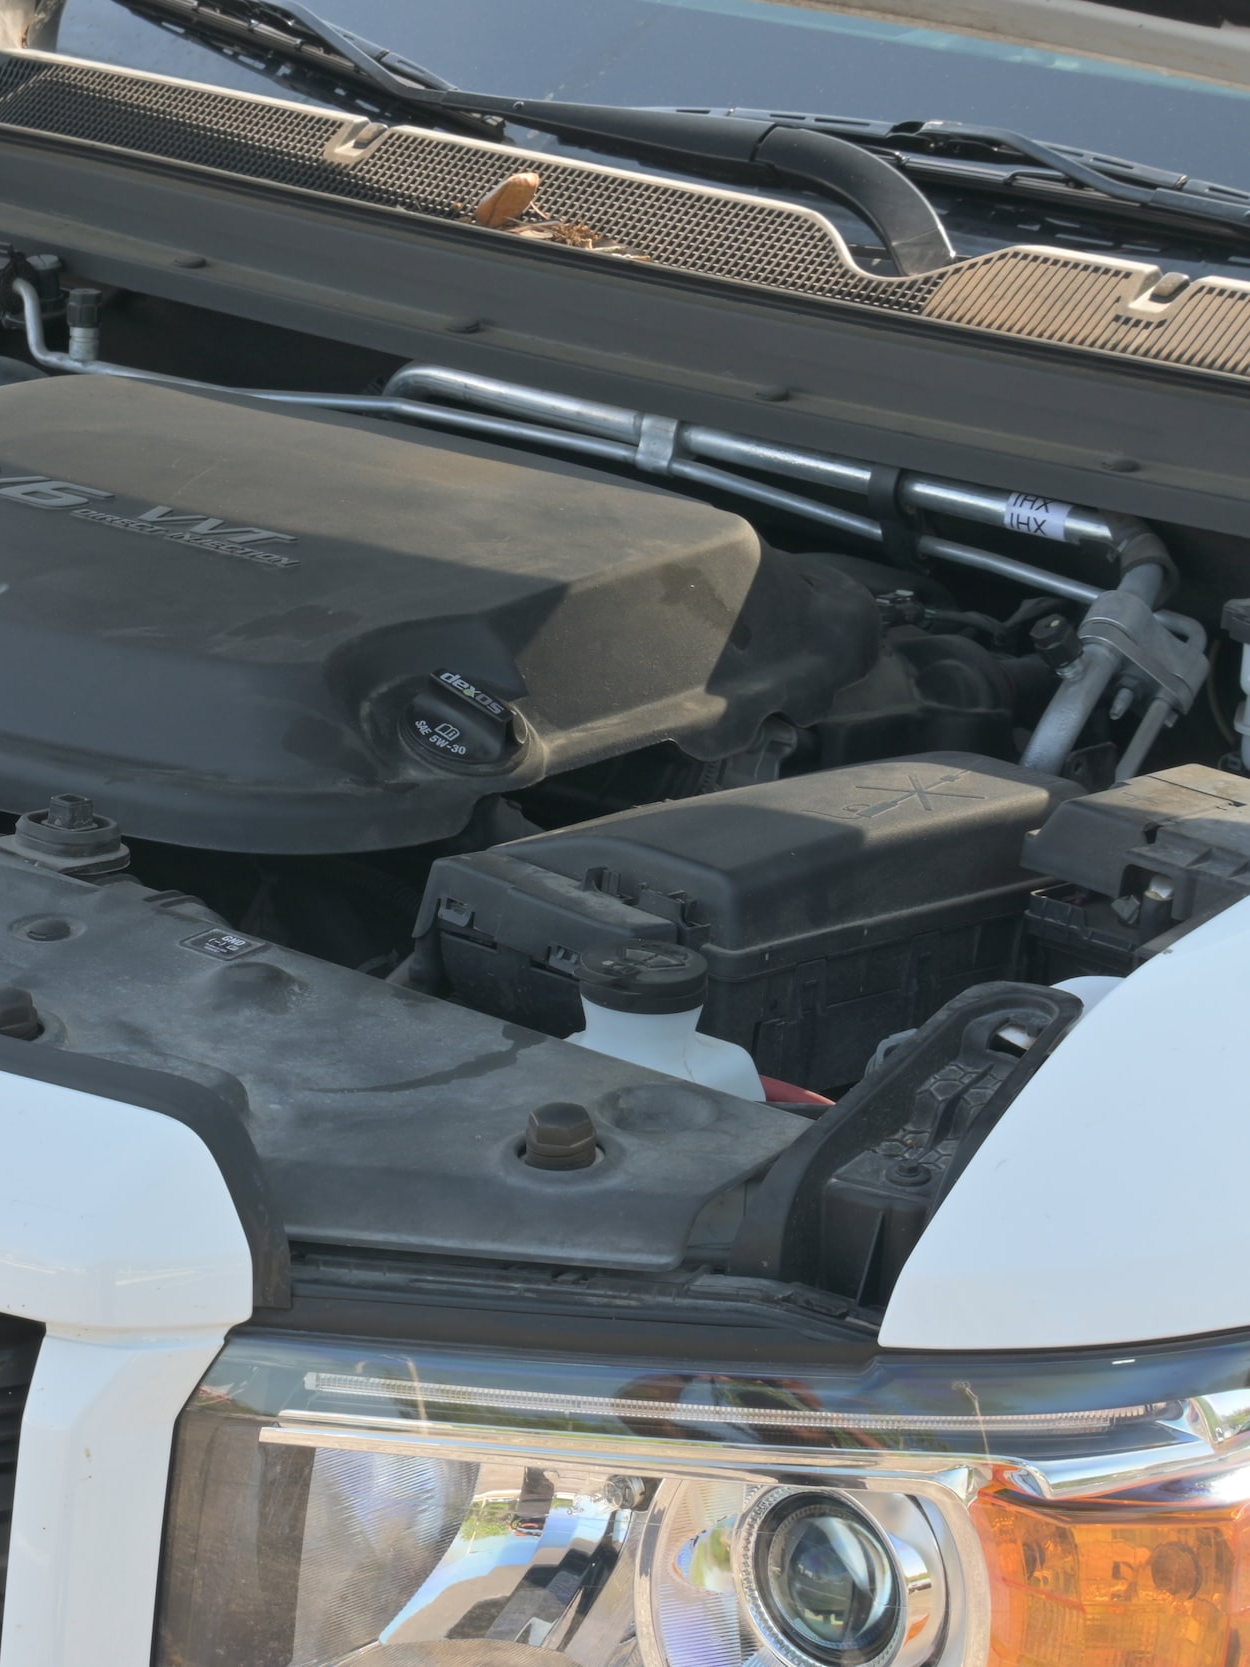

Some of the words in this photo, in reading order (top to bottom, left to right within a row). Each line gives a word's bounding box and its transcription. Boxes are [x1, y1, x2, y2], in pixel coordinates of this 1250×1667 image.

[70, 508, 170, 536] DIRECT
[164, 531, 301, 568] INJECTION
[137, 505, 298, 545] VVT
[1010, 512, 1047, 536] IHX
[440, 672, 505, 715] dexos
[415, 720, 432, 736] SAE
[429, 734, 467, 755] 5W-30
[221, 935, 246, 946] GND
